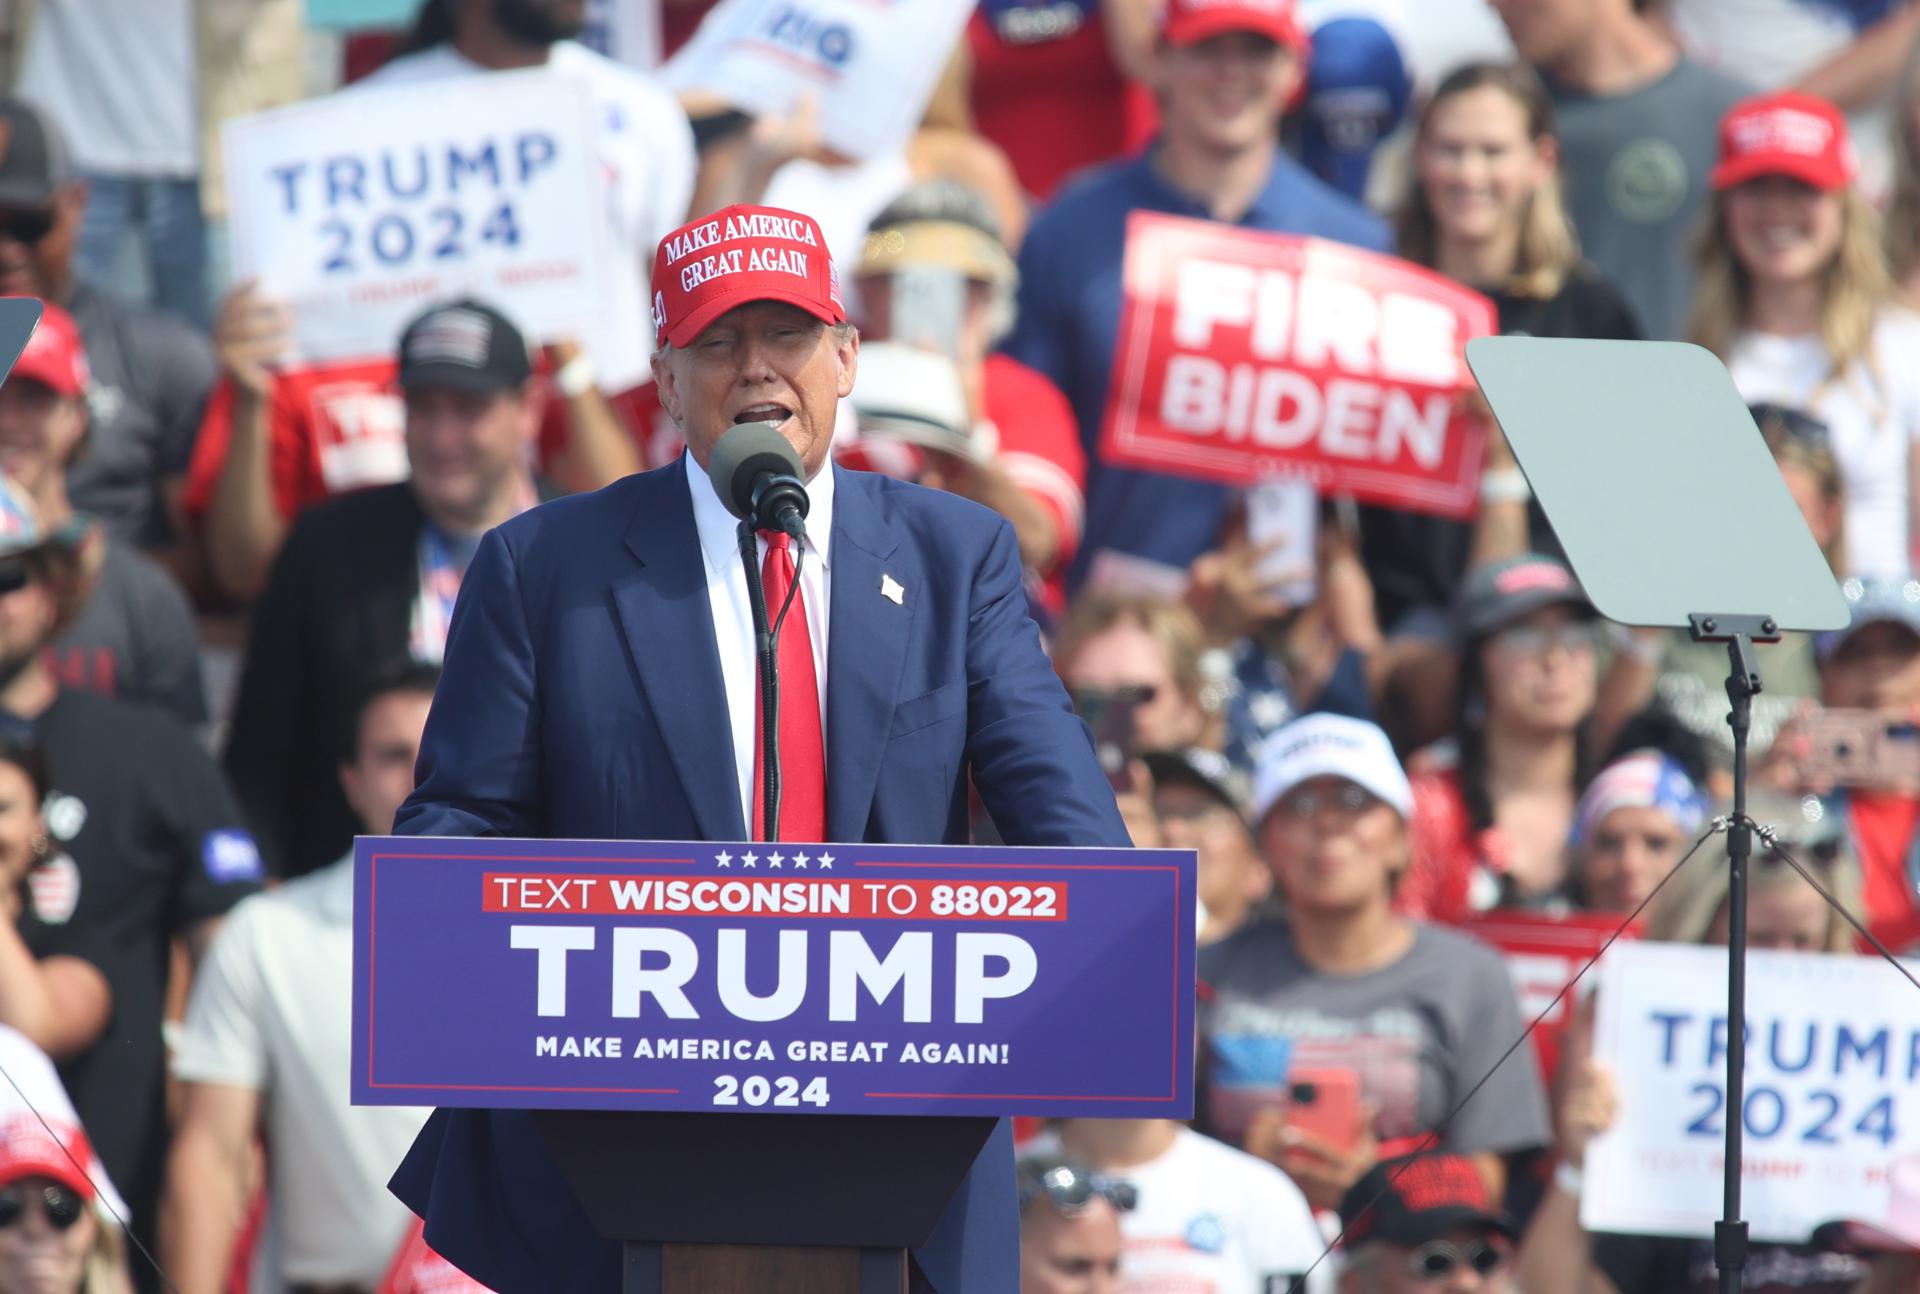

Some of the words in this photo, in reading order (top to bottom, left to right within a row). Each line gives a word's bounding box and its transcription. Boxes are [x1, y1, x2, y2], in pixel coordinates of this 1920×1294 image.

[269, 131, 557, 213] TRUMP
[319, 203, 520, 271] 2024
[664, 220, 721, 266] MAKE
[724, 214, 818, 247] AMERICA
[681, 249, 744, 292] GREAT
[747, 247, 808, 279] AGAIN
[1172, 257, 1458, 385] FIRE
[1159, 352, 1450, 469] BIDEN
[494, 877, 597, 909] TEXT
[609, 880, 850, 914] WISCONSIN
[863, 884, 918, 915] TO
[930, 885, 1057, 917] 88022
[510, 925, 1038, 1024] TRUMP
[536, 1036, 622, 1058] MAKE
[633, 1038, 776, 1061] AMERICA
[787, 1041, 889, 1063] GREAT
[899, 1042, 1010, 1065] AGAIN!
[713, 1074, 831, 1107] 2024
[1685, 1082, 1896, 1146] 2024
